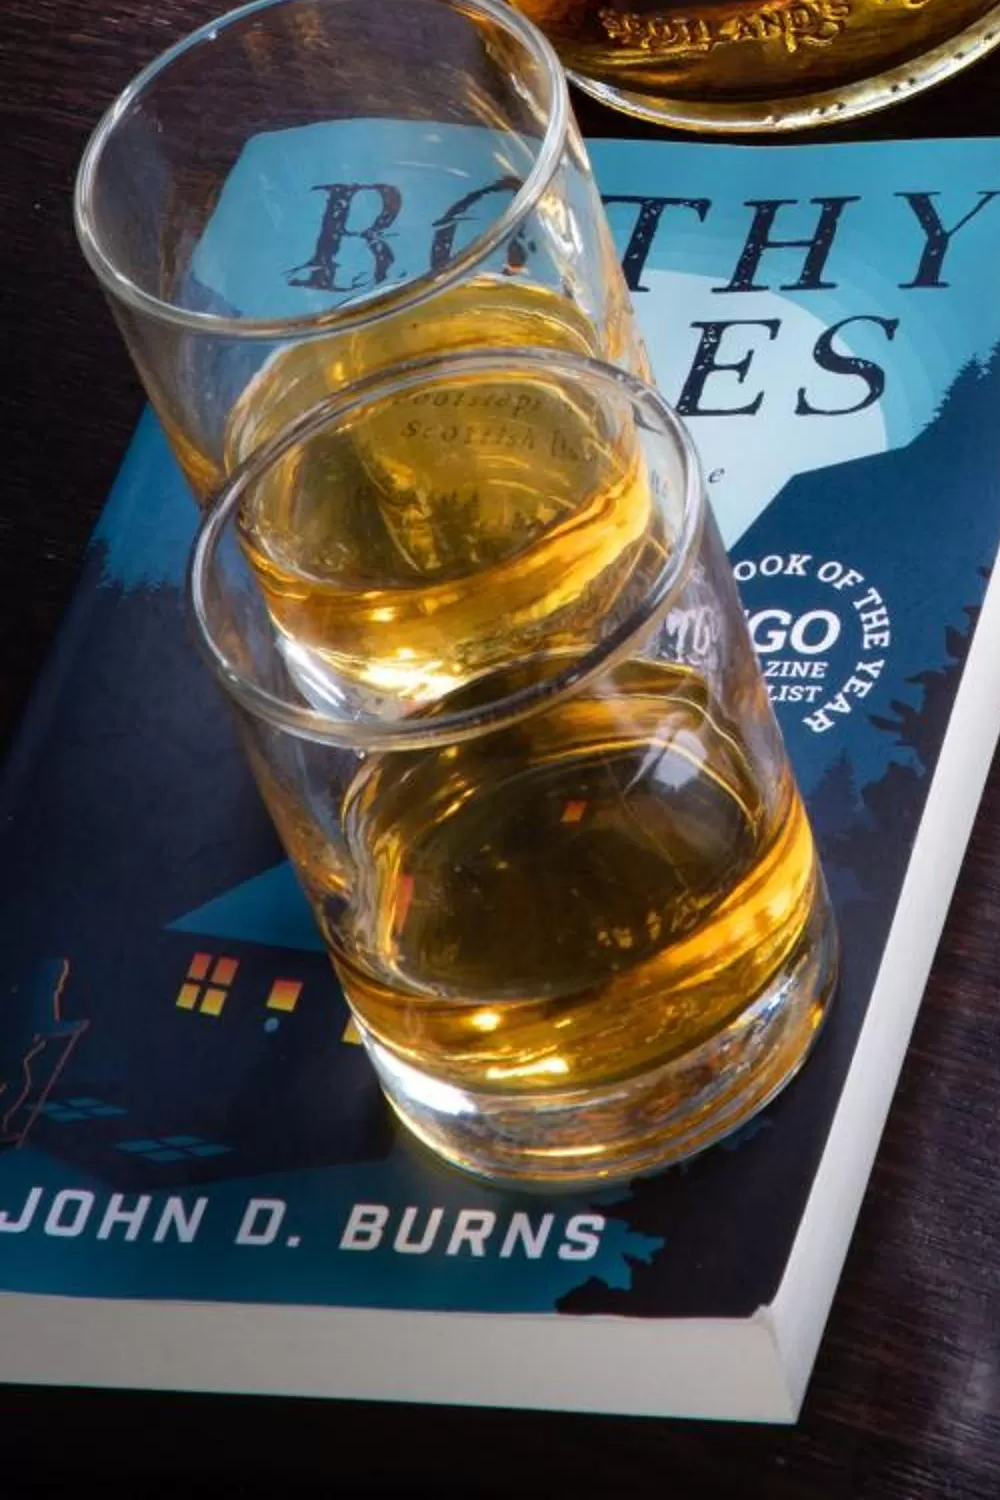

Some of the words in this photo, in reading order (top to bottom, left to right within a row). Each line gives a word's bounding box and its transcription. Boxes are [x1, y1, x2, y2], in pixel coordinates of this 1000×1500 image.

[732, 552, 813, 582] OOK
[816, 560, 865, 592] OF
[748, 608, 841, 655] GO
[852, 587, 891, 650] THE
[763, 660, 829, 679] ZINE
[802, 659, 885, 735] YEAR
[0, 1186, 208, 1244] JOHN
[233, 1197, 301, 1248] D.
[339, 1202, 606, 1262] BURNS
